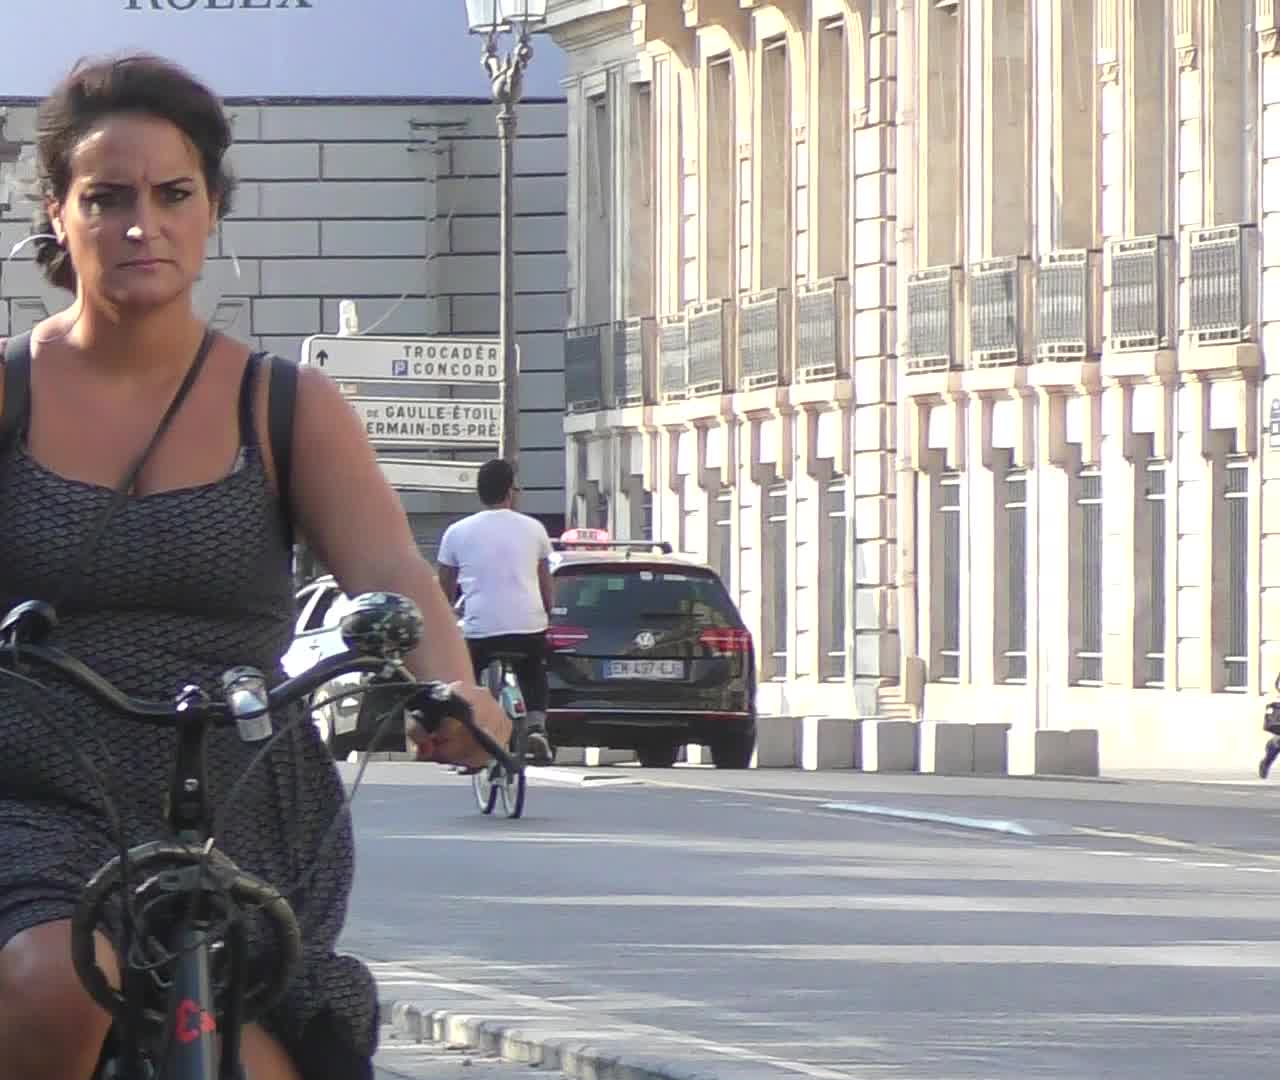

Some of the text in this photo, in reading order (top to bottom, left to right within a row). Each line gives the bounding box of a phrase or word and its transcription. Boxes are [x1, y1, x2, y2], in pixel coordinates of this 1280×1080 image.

[404, 345, 497, 360] TROCADÉR
[414, 362, 497, 376] CONCORD
[386, 405, 499, 420] GAULLE-ÉTOIL
[367, 422, 500, 435] ERMAIN-DES-PRÉ
